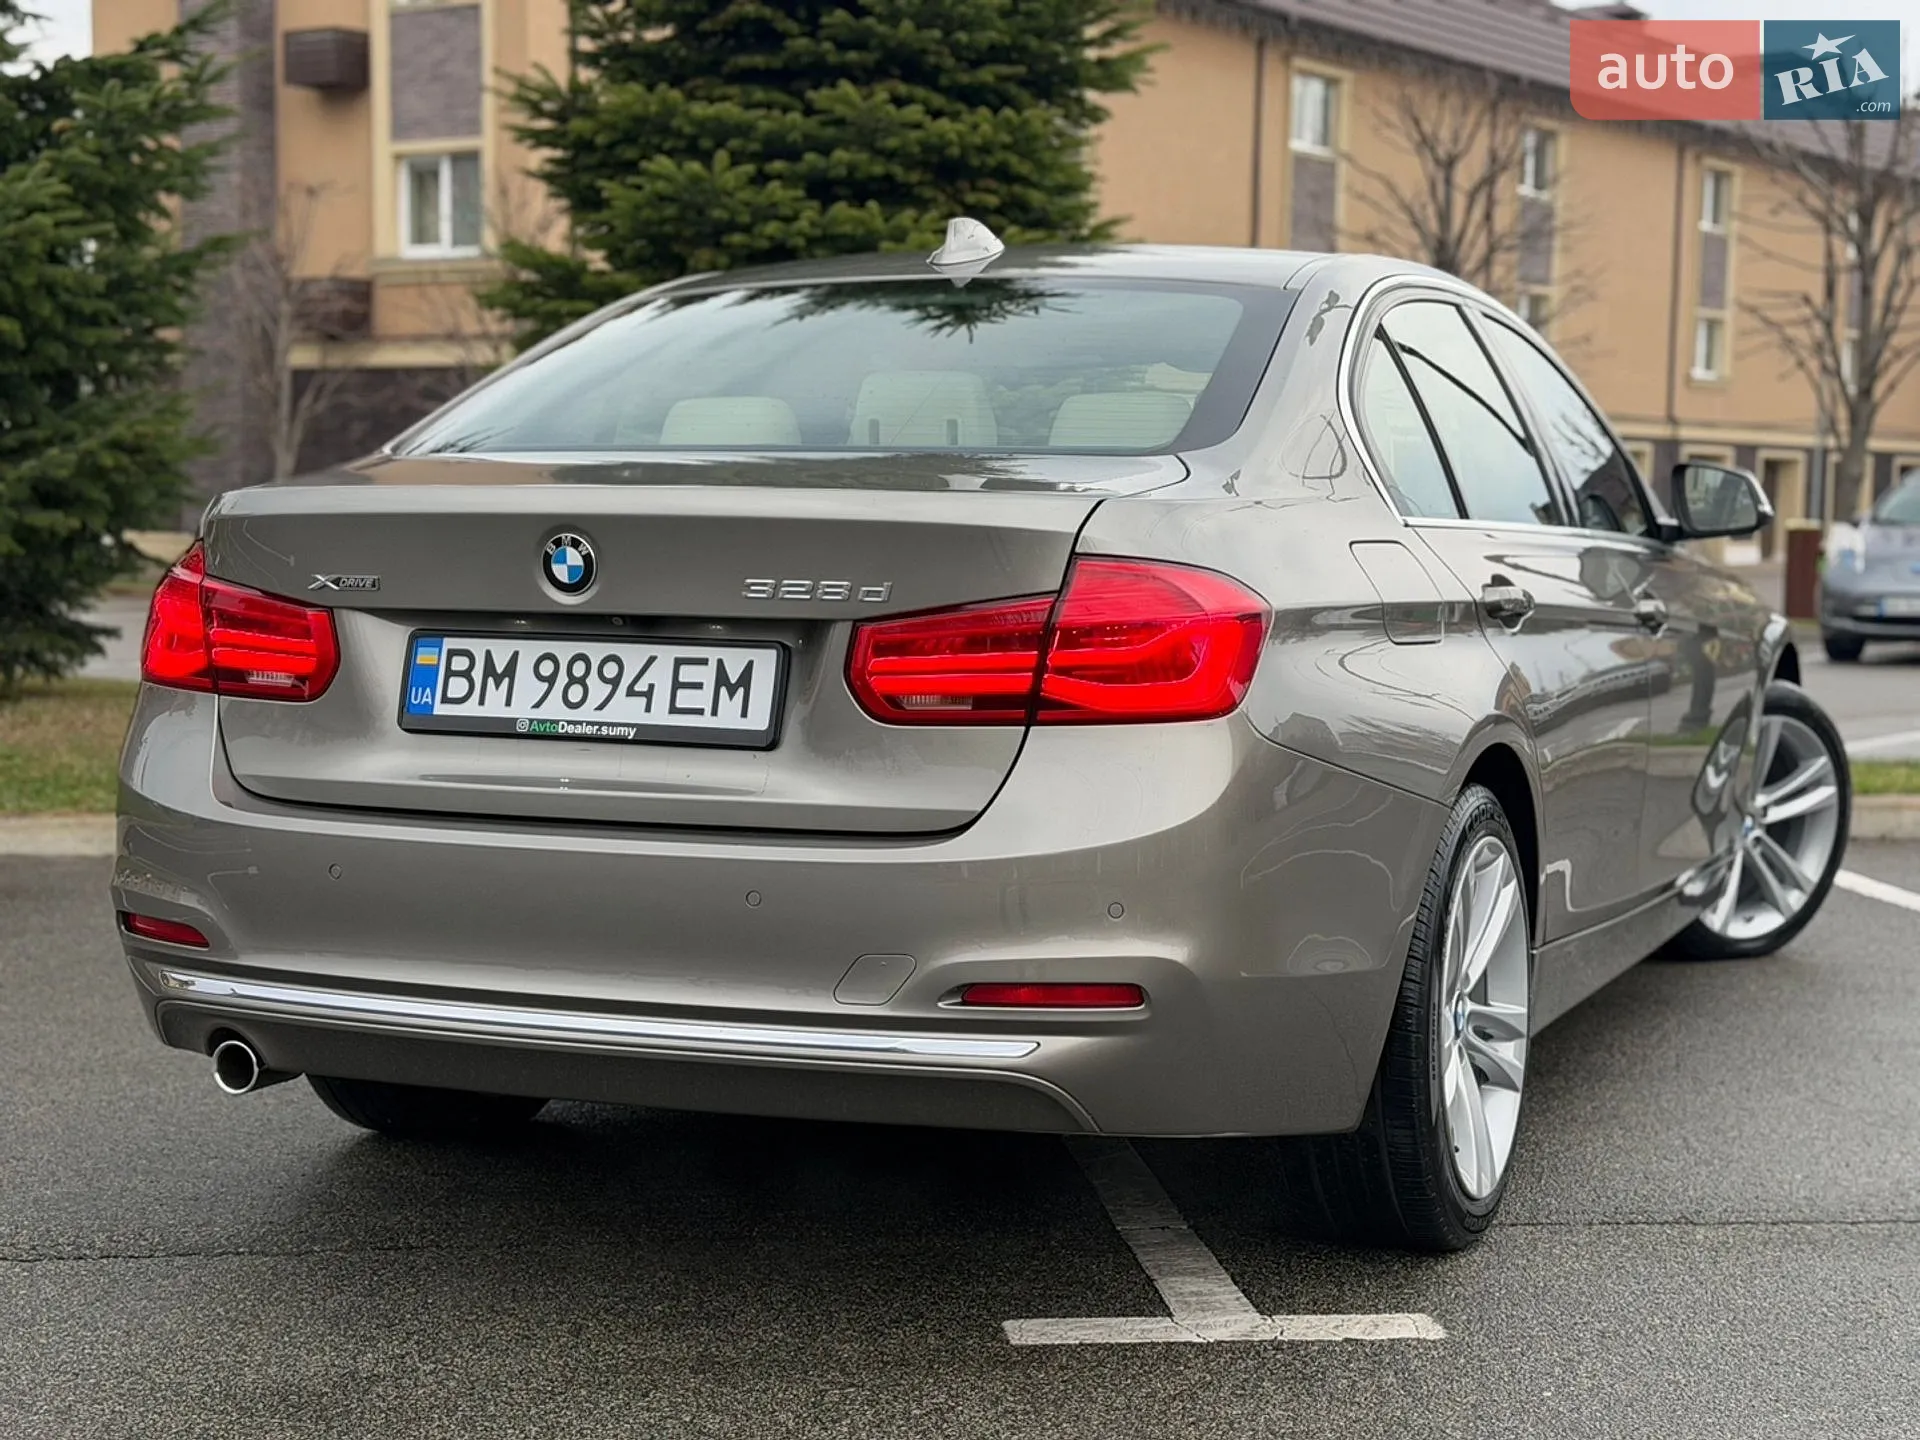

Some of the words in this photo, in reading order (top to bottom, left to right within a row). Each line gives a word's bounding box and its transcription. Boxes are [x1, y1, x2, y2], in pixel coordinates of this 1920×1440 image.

[546, 535, 590, 556] BMW
[742, 578, 893, 602] 328d
[440, 647, 520, 708] BM
[530, 651, 658, 714] 9894
[668, 655, 755, 719] EM
[411, 685, 432, 706] UA
